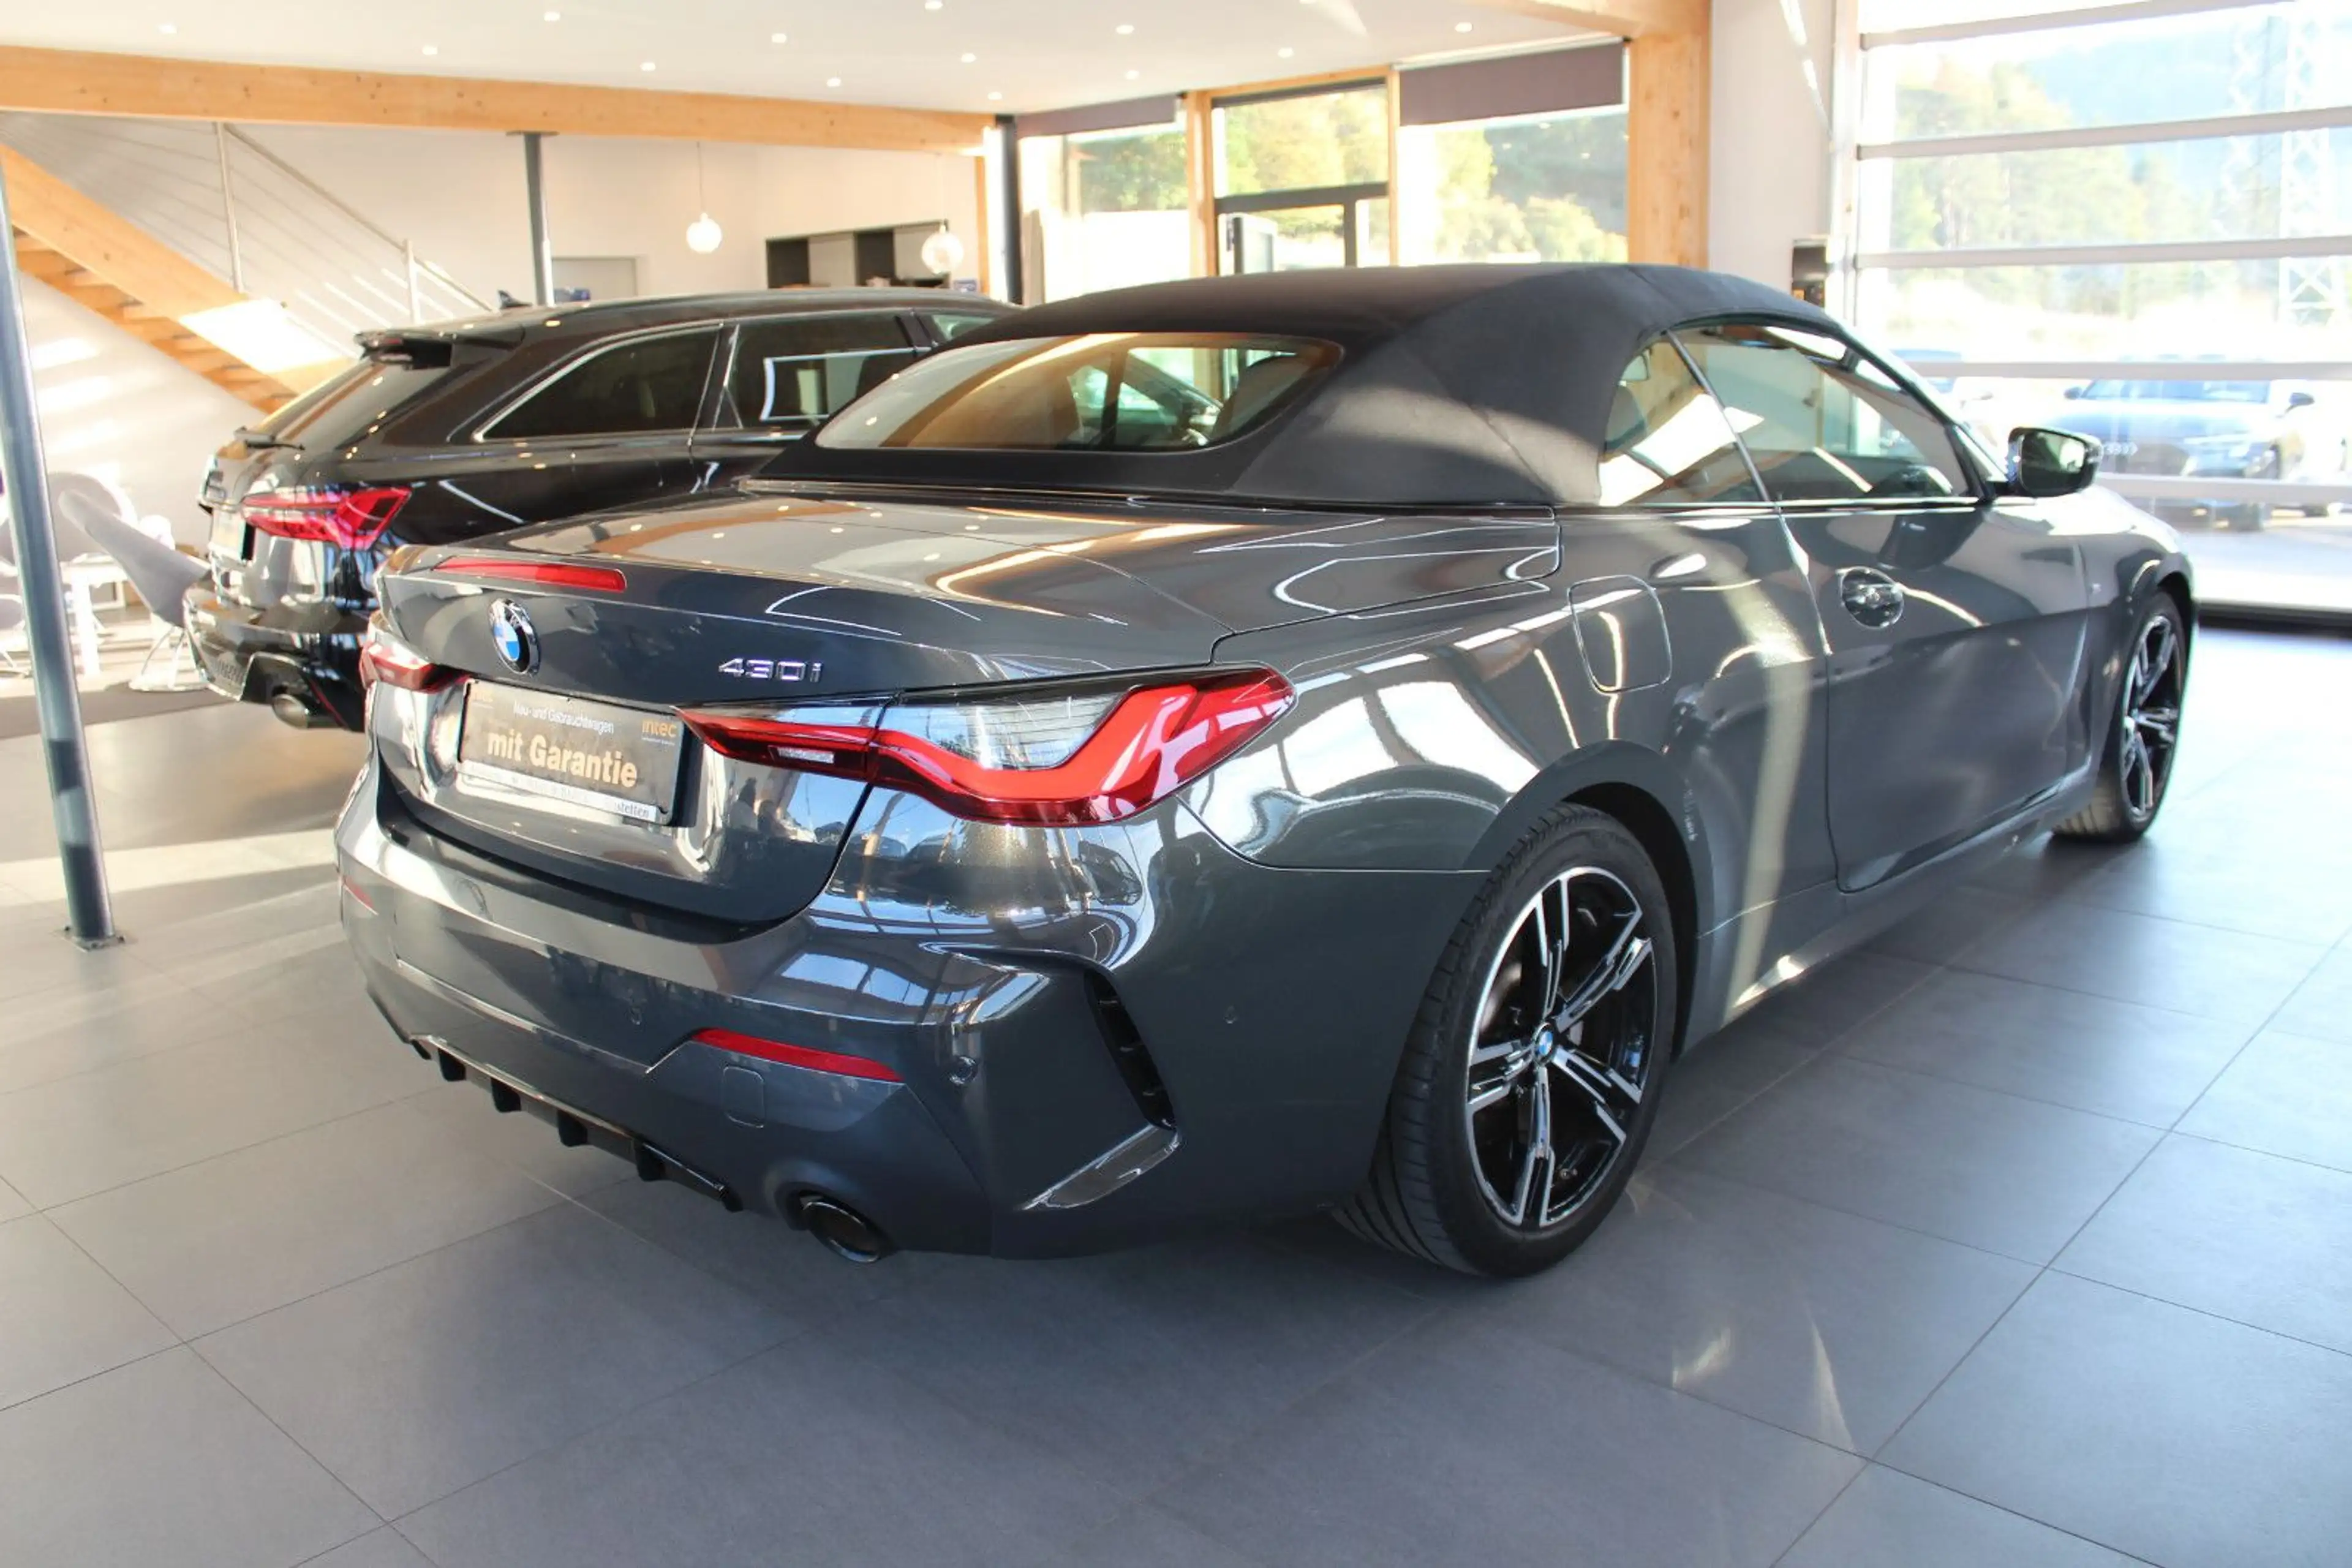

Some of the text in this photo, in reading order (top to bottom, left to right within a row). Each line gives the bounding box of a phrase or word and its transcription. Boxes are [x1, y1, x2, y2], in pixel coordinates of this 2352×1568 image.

[718, 658, 822, 682] 430i
[488, 728, 523, 761] mit
[529, 734, 638, 788] Garantie
